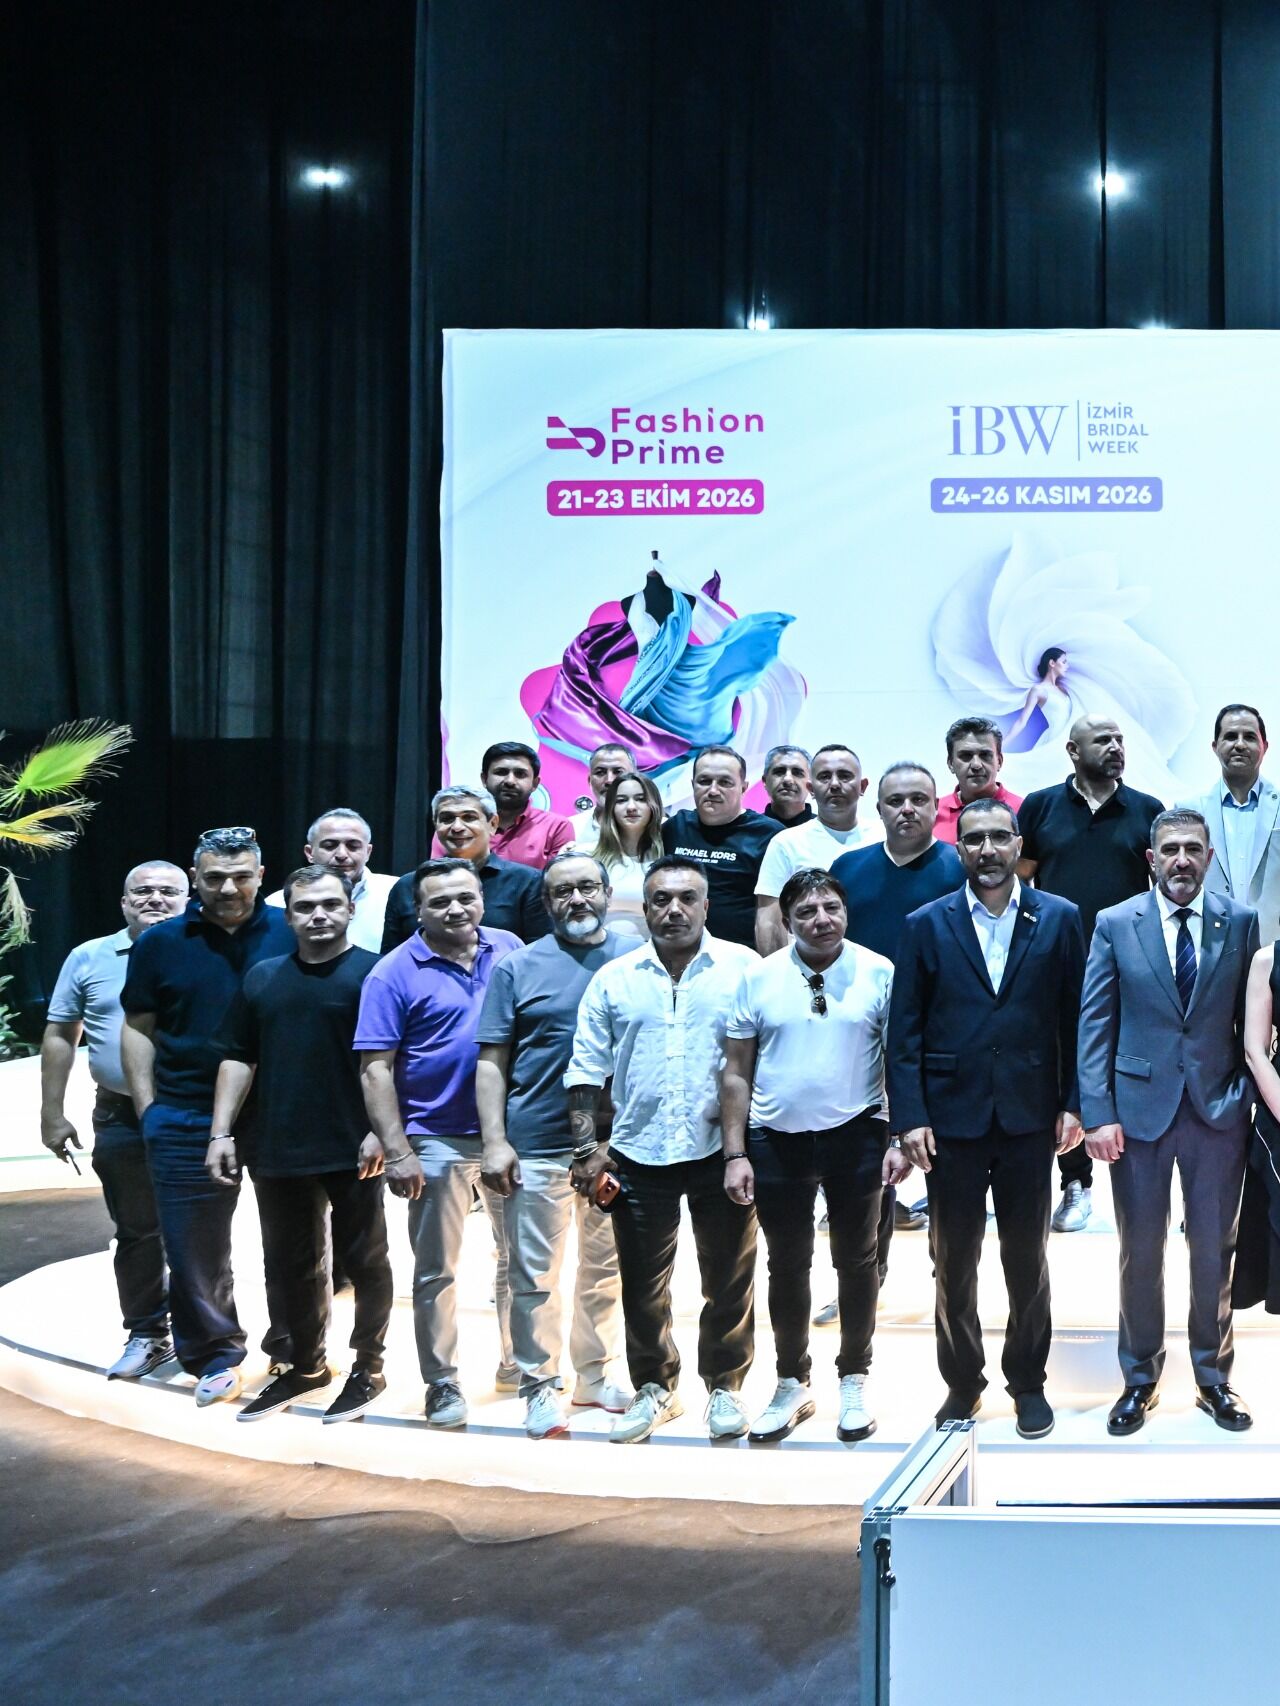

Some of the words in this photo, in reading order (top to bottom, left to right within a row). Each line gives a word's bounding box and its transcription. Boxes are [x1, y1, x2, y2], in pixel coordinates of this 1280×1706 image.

[611, 407, 764, 433] Fashion
[1087, 423, 1149, 436] BRIDAL
[611, 439, 725, 464] Prime
[1087, 441, 1139, 454] WEEK
[557, 489, 625, 509] 21-23
[631, 482, 690, 509] EKİM
[696, 487, 756, 508] 2026
[941, 485, 1010, 505] 24-26
[1015, 485, 1091, 505] KASIM
[1096, 485, 1153, 505] 2026
[674, 847, 708, 857] MICHAEL
[710, 851, 736, 861] KORS
